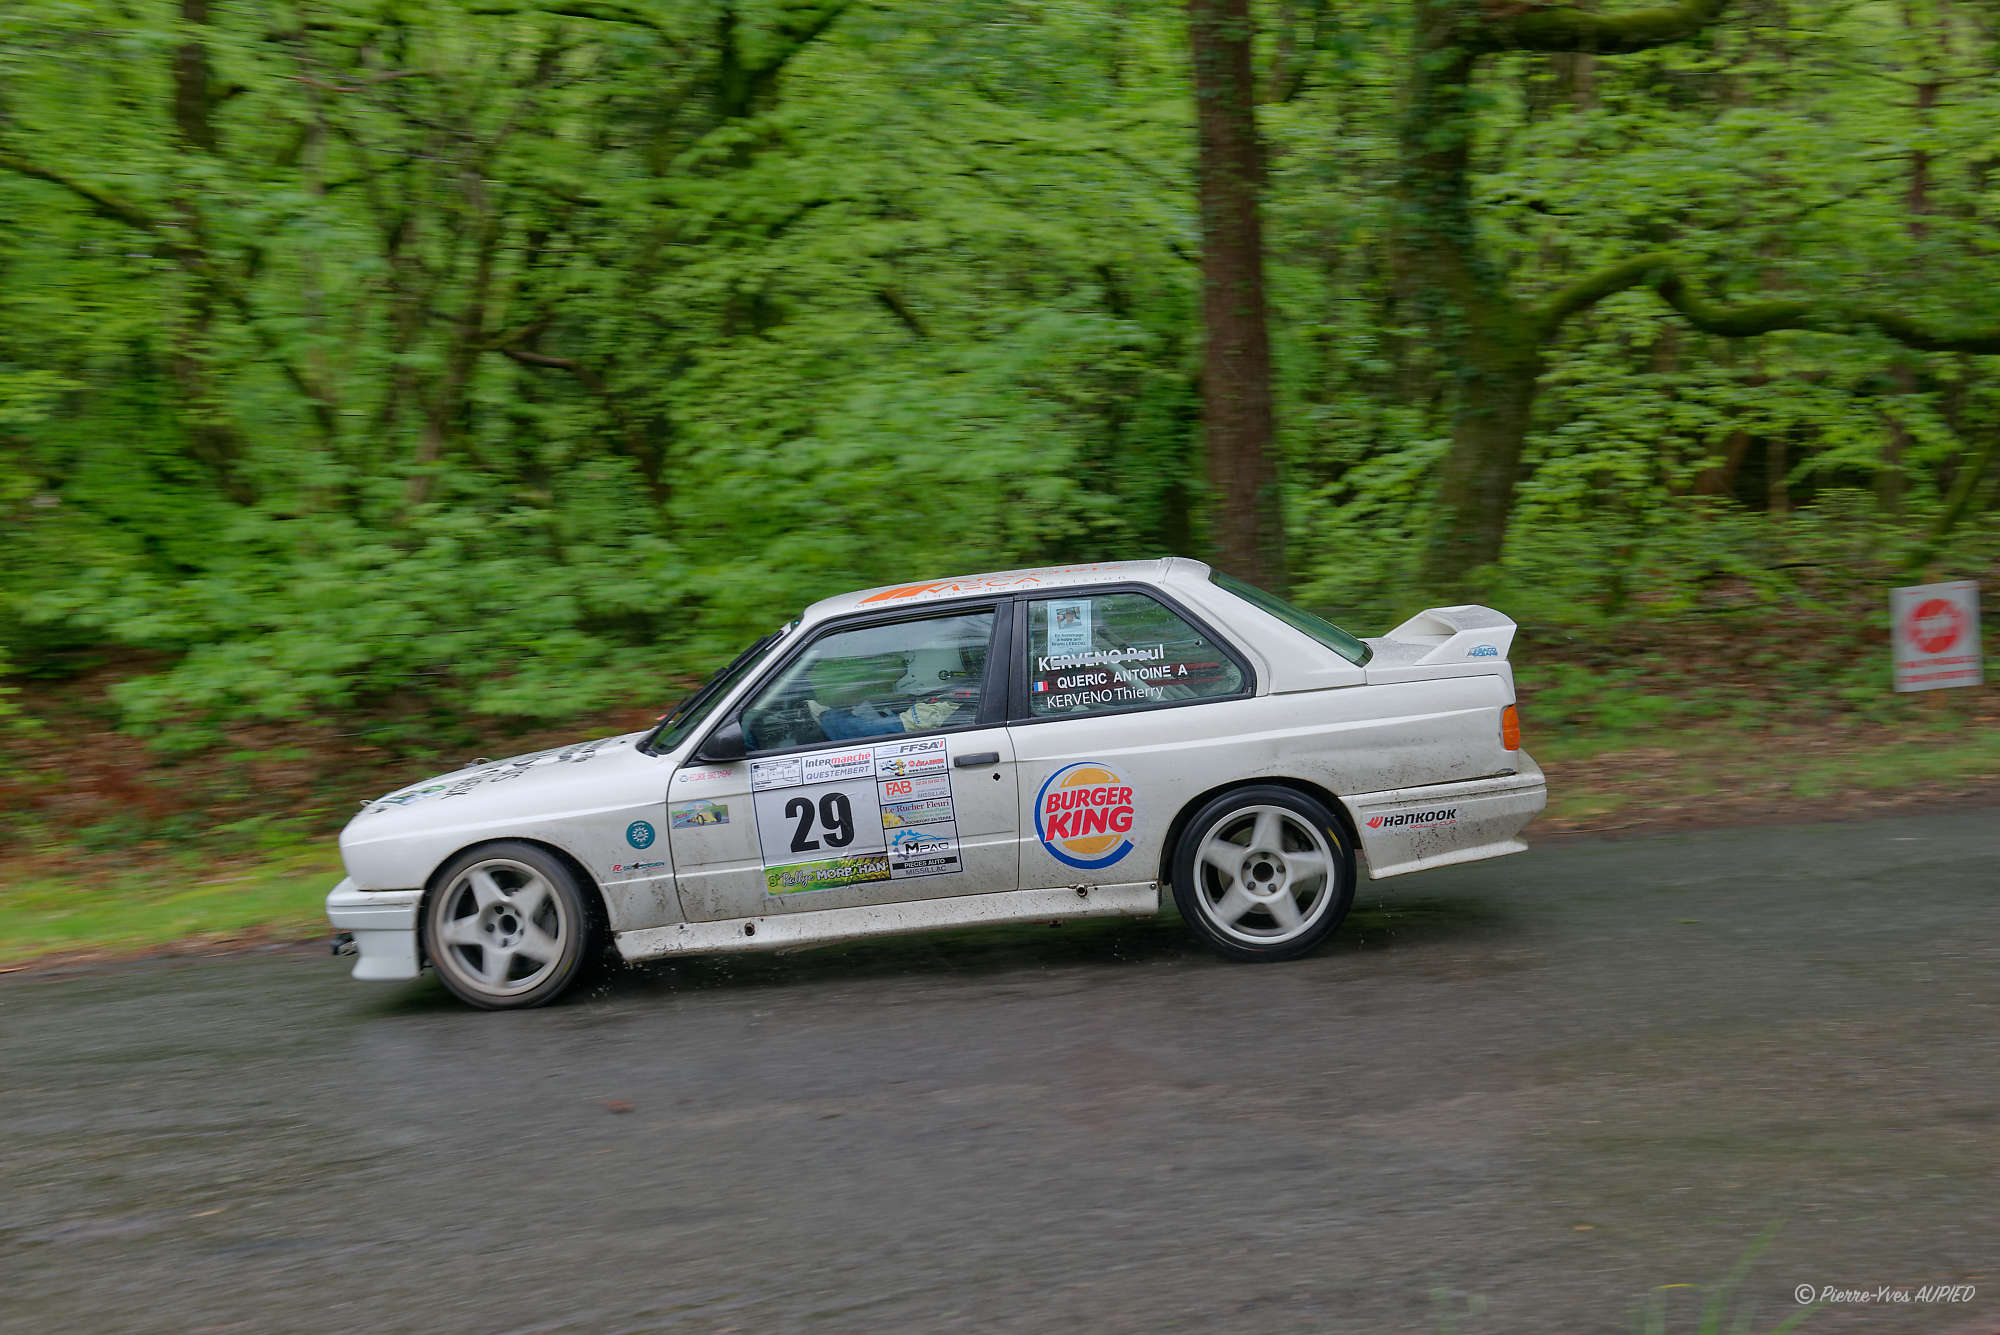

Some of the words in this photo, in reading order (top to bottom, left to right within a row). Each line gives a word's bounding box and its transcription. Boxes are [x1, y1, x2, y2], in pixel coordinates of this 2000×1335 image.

[1056, 672, 1108, 689] QUERIC
[1113, 666, 1172, 683] ANTOINE
[1047, 689, 1113, 709] KERVENO
[1114, 685, 1164, 704] Thierry
[900, 741, 938, 753] FFSA
[806, 765, 869, 780] QUESTEMBERT
[885, 780, 912, 796] FAB
[896, 802, 924, 812] Rucher
[926, 799, 949, 808] Fleuri
[1045, 786, 1133, 814] BURGER
[785, 792, 855, 853] 29
[1045, 805, 1134, 841] KING
[781, 870, 815, 887] Rallye
[905, 866, 947, 875] MISSILLAC
